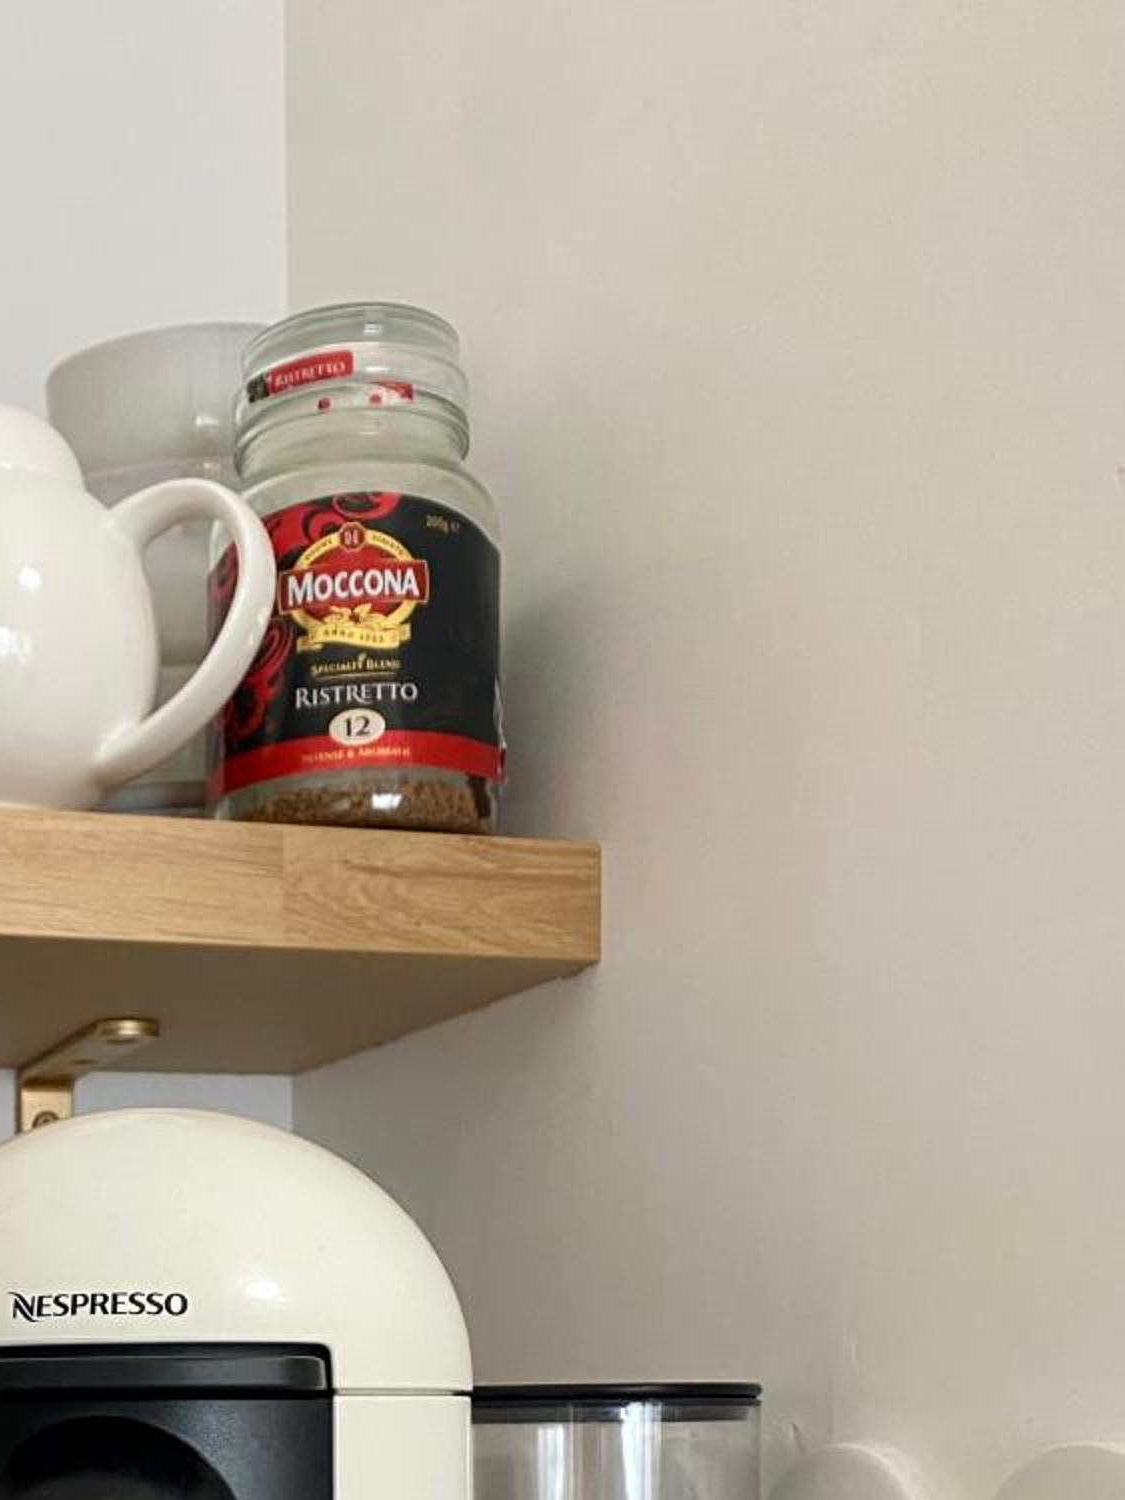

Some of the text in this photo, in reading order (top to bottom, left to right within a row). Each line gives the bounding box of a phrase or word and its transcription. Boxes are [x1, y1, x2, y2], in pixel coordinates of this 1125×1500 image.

[287, 567, 420, 607] MOCCONA
[295, 682, 418, 709] RISTRETTO
[345, 715, 370, 737] 12
[7, 1291, 188, 1322] NESPRESSO
